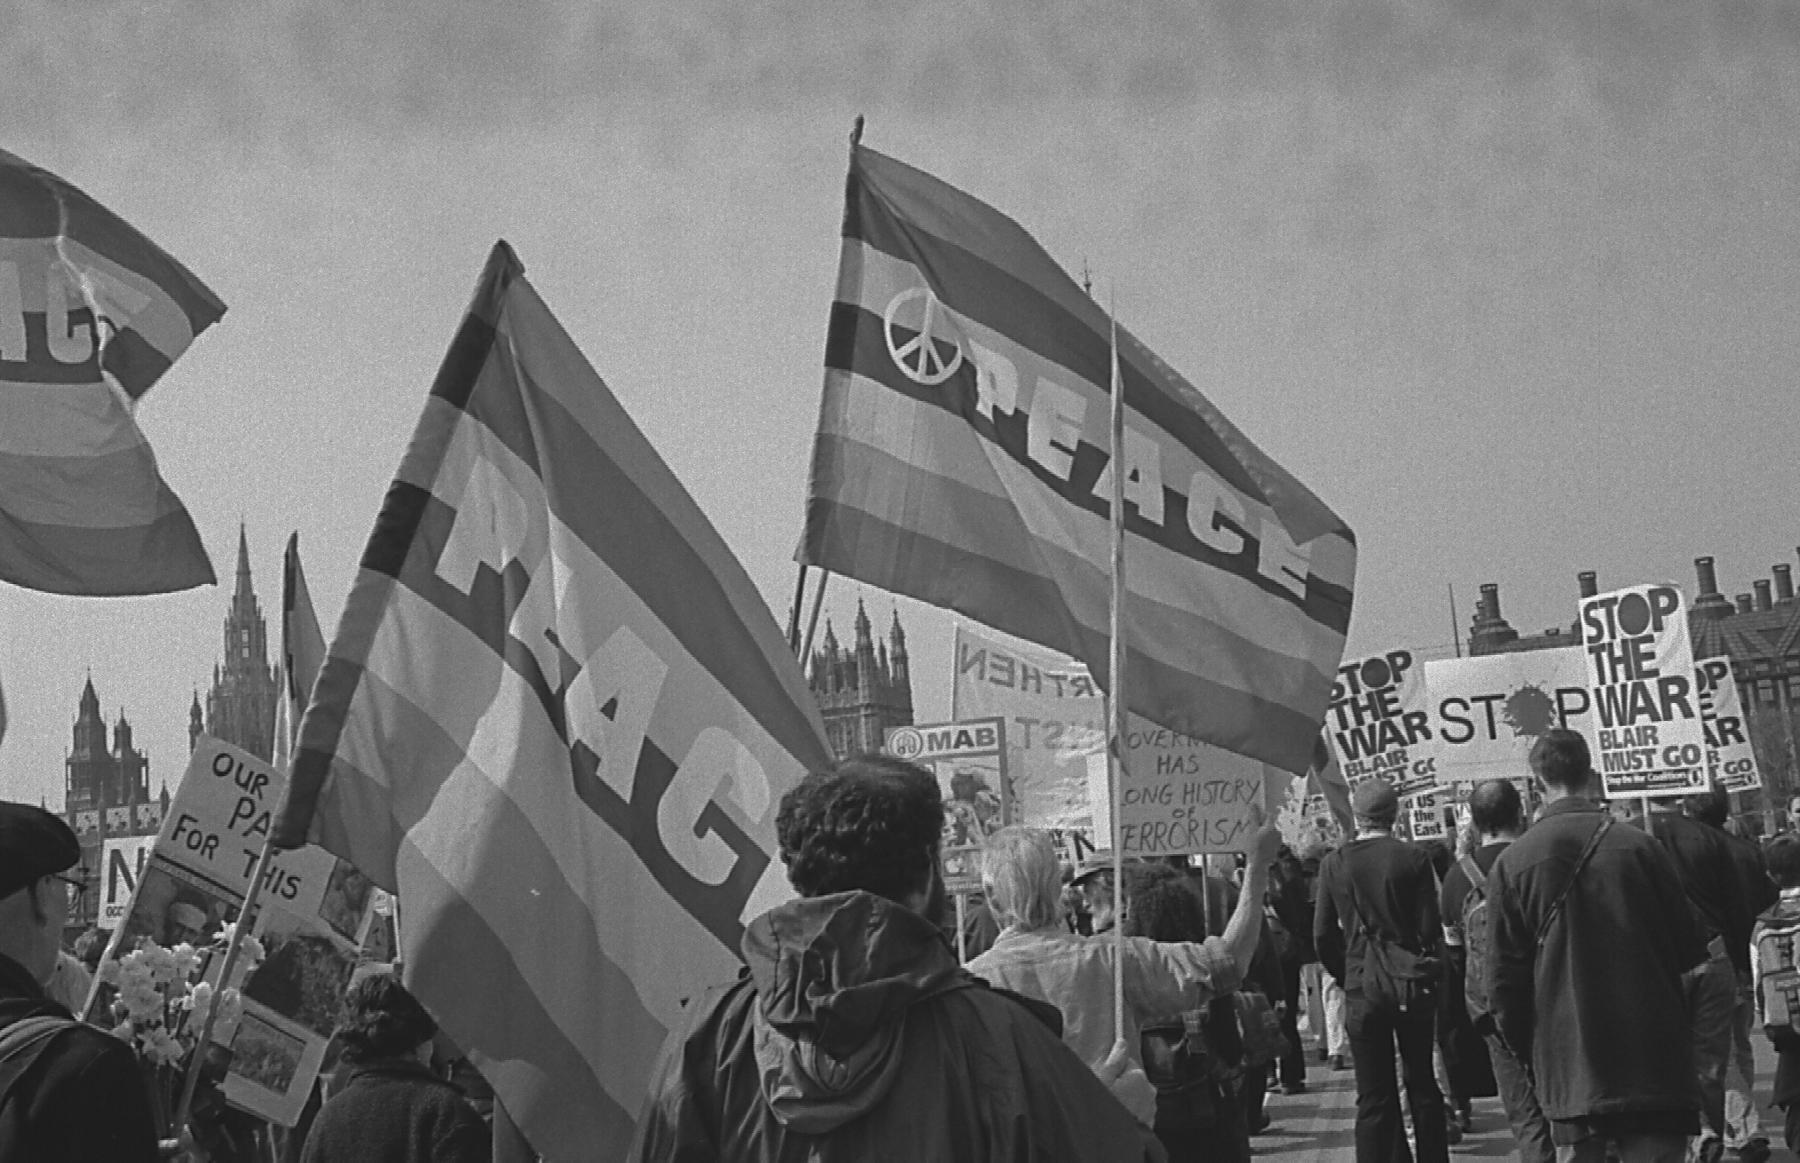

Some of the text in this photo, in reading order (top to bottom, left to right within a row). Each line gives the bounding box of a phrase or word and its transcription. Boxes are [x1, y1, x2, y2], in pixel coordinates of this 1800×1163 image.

[968, 337, 1313, 600] PEACE
[1582, 586, 1679, 644] STOP
[1588, 634, 1660, 686] THE
[434, 455, 798, 928] PEAC
[1328, 685, 1403, 731] THE
[1595, 673, 1695, 730] WAR
[927, 728, 996, 751] MAB
[1336, 711, 1433, 761] WAR
[1600, 725, 1659, 750] BLAIR
[1602, 748, 1656, 773] MUST
[1662, 743, 1701, 766] GO
[212, 752, 269, 800] OUR
[1157, 754, 1199, 775] HAS
[1344, 748, 1408, 778] BLAIR
[1724, 758, 1753, 775] GO
[1121, 778, 1261, 807] ONG HISTORY
[1414, 822, 1442, 836] East
[171, 814, 301, 900] FOR THIS
